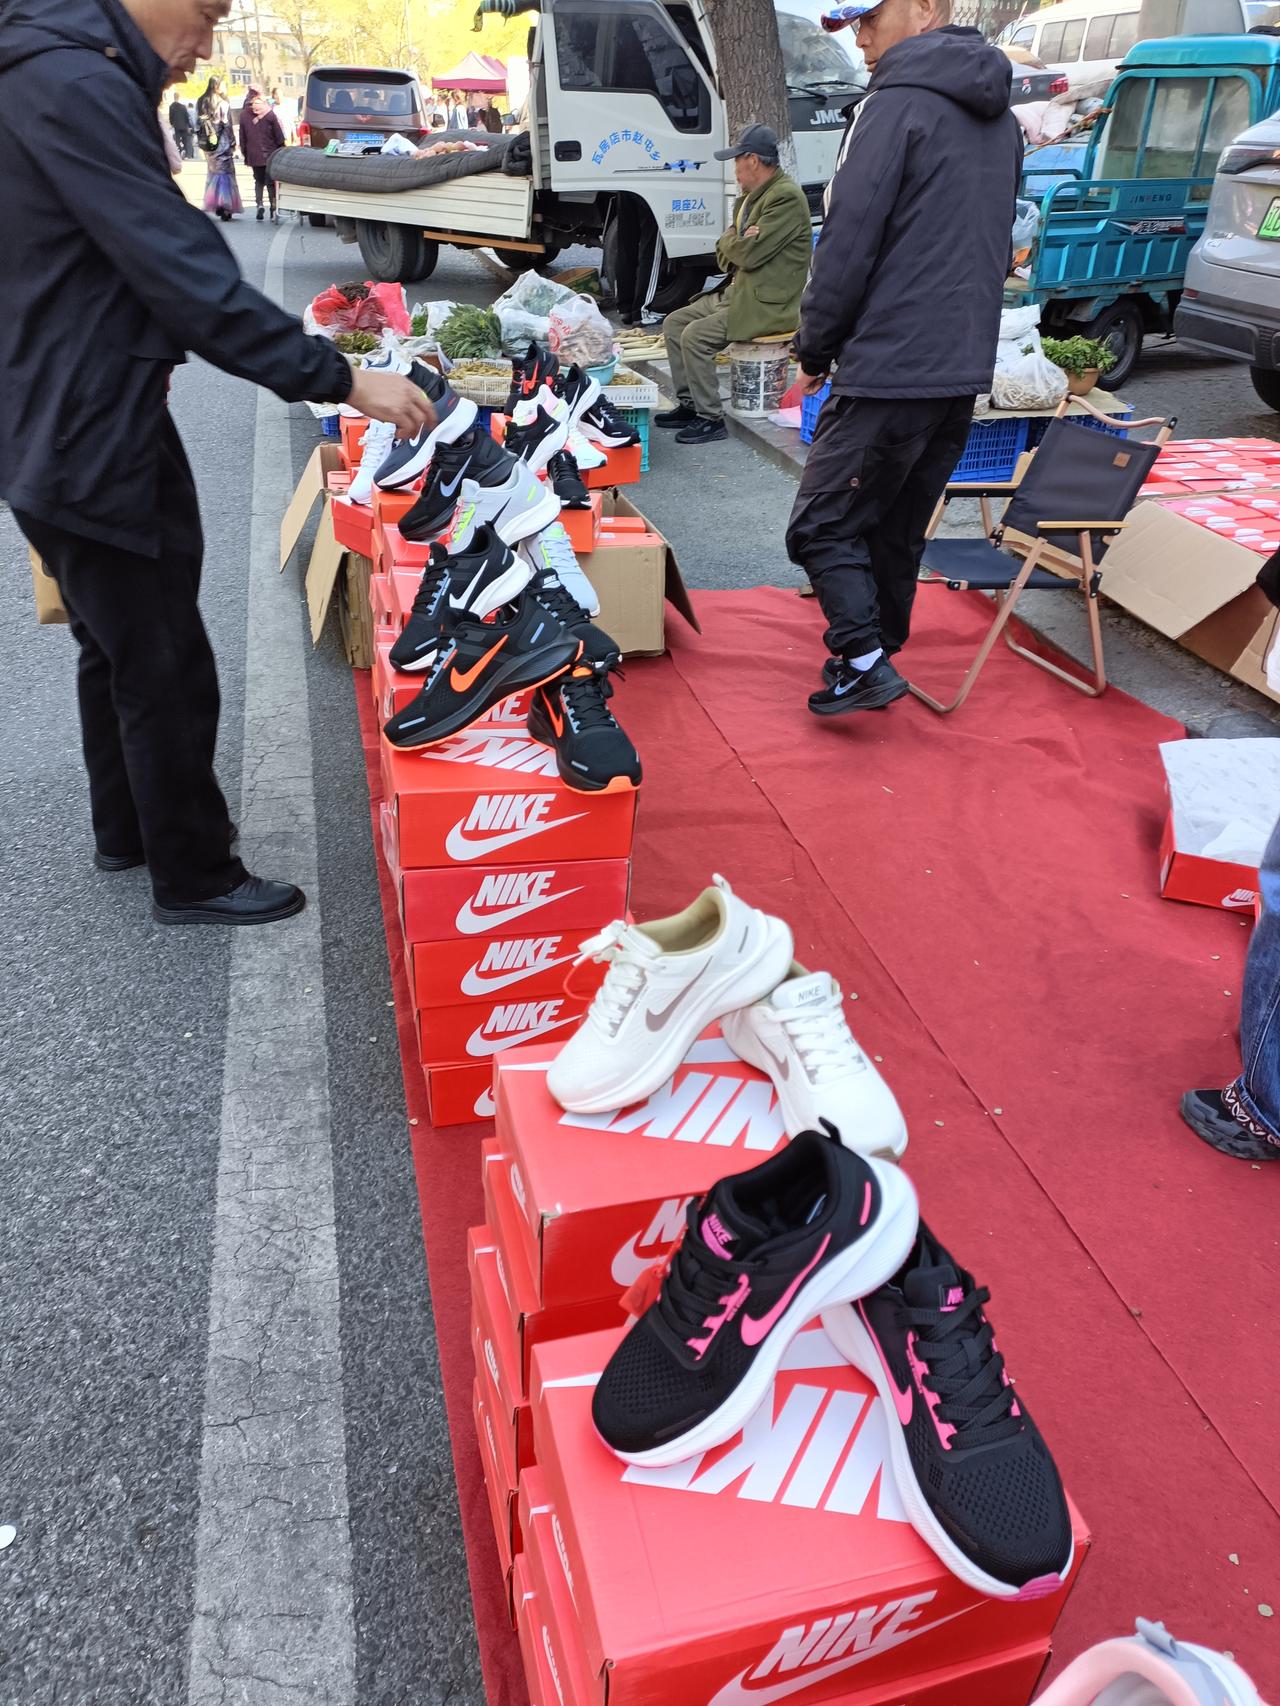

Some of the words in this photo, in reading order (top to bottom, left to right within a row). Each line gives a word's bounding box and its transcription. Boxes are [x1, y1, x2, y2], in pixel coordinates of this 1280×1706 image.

[810, 108, 847, 125] JMC
[671, 198, 706, 212] 限座2人
[463, 793, 557, 831] NIKE
[473, 870, 556, 908] NIKE
[478, 936, 563, 972] NIKE
[798, 985, 821, 1002] NIKE
[482, 999, 566, 1034] NIKE
[706, 1213, 733, 1246] NIKE
[749, 1589, 938, 1681] NIKE
